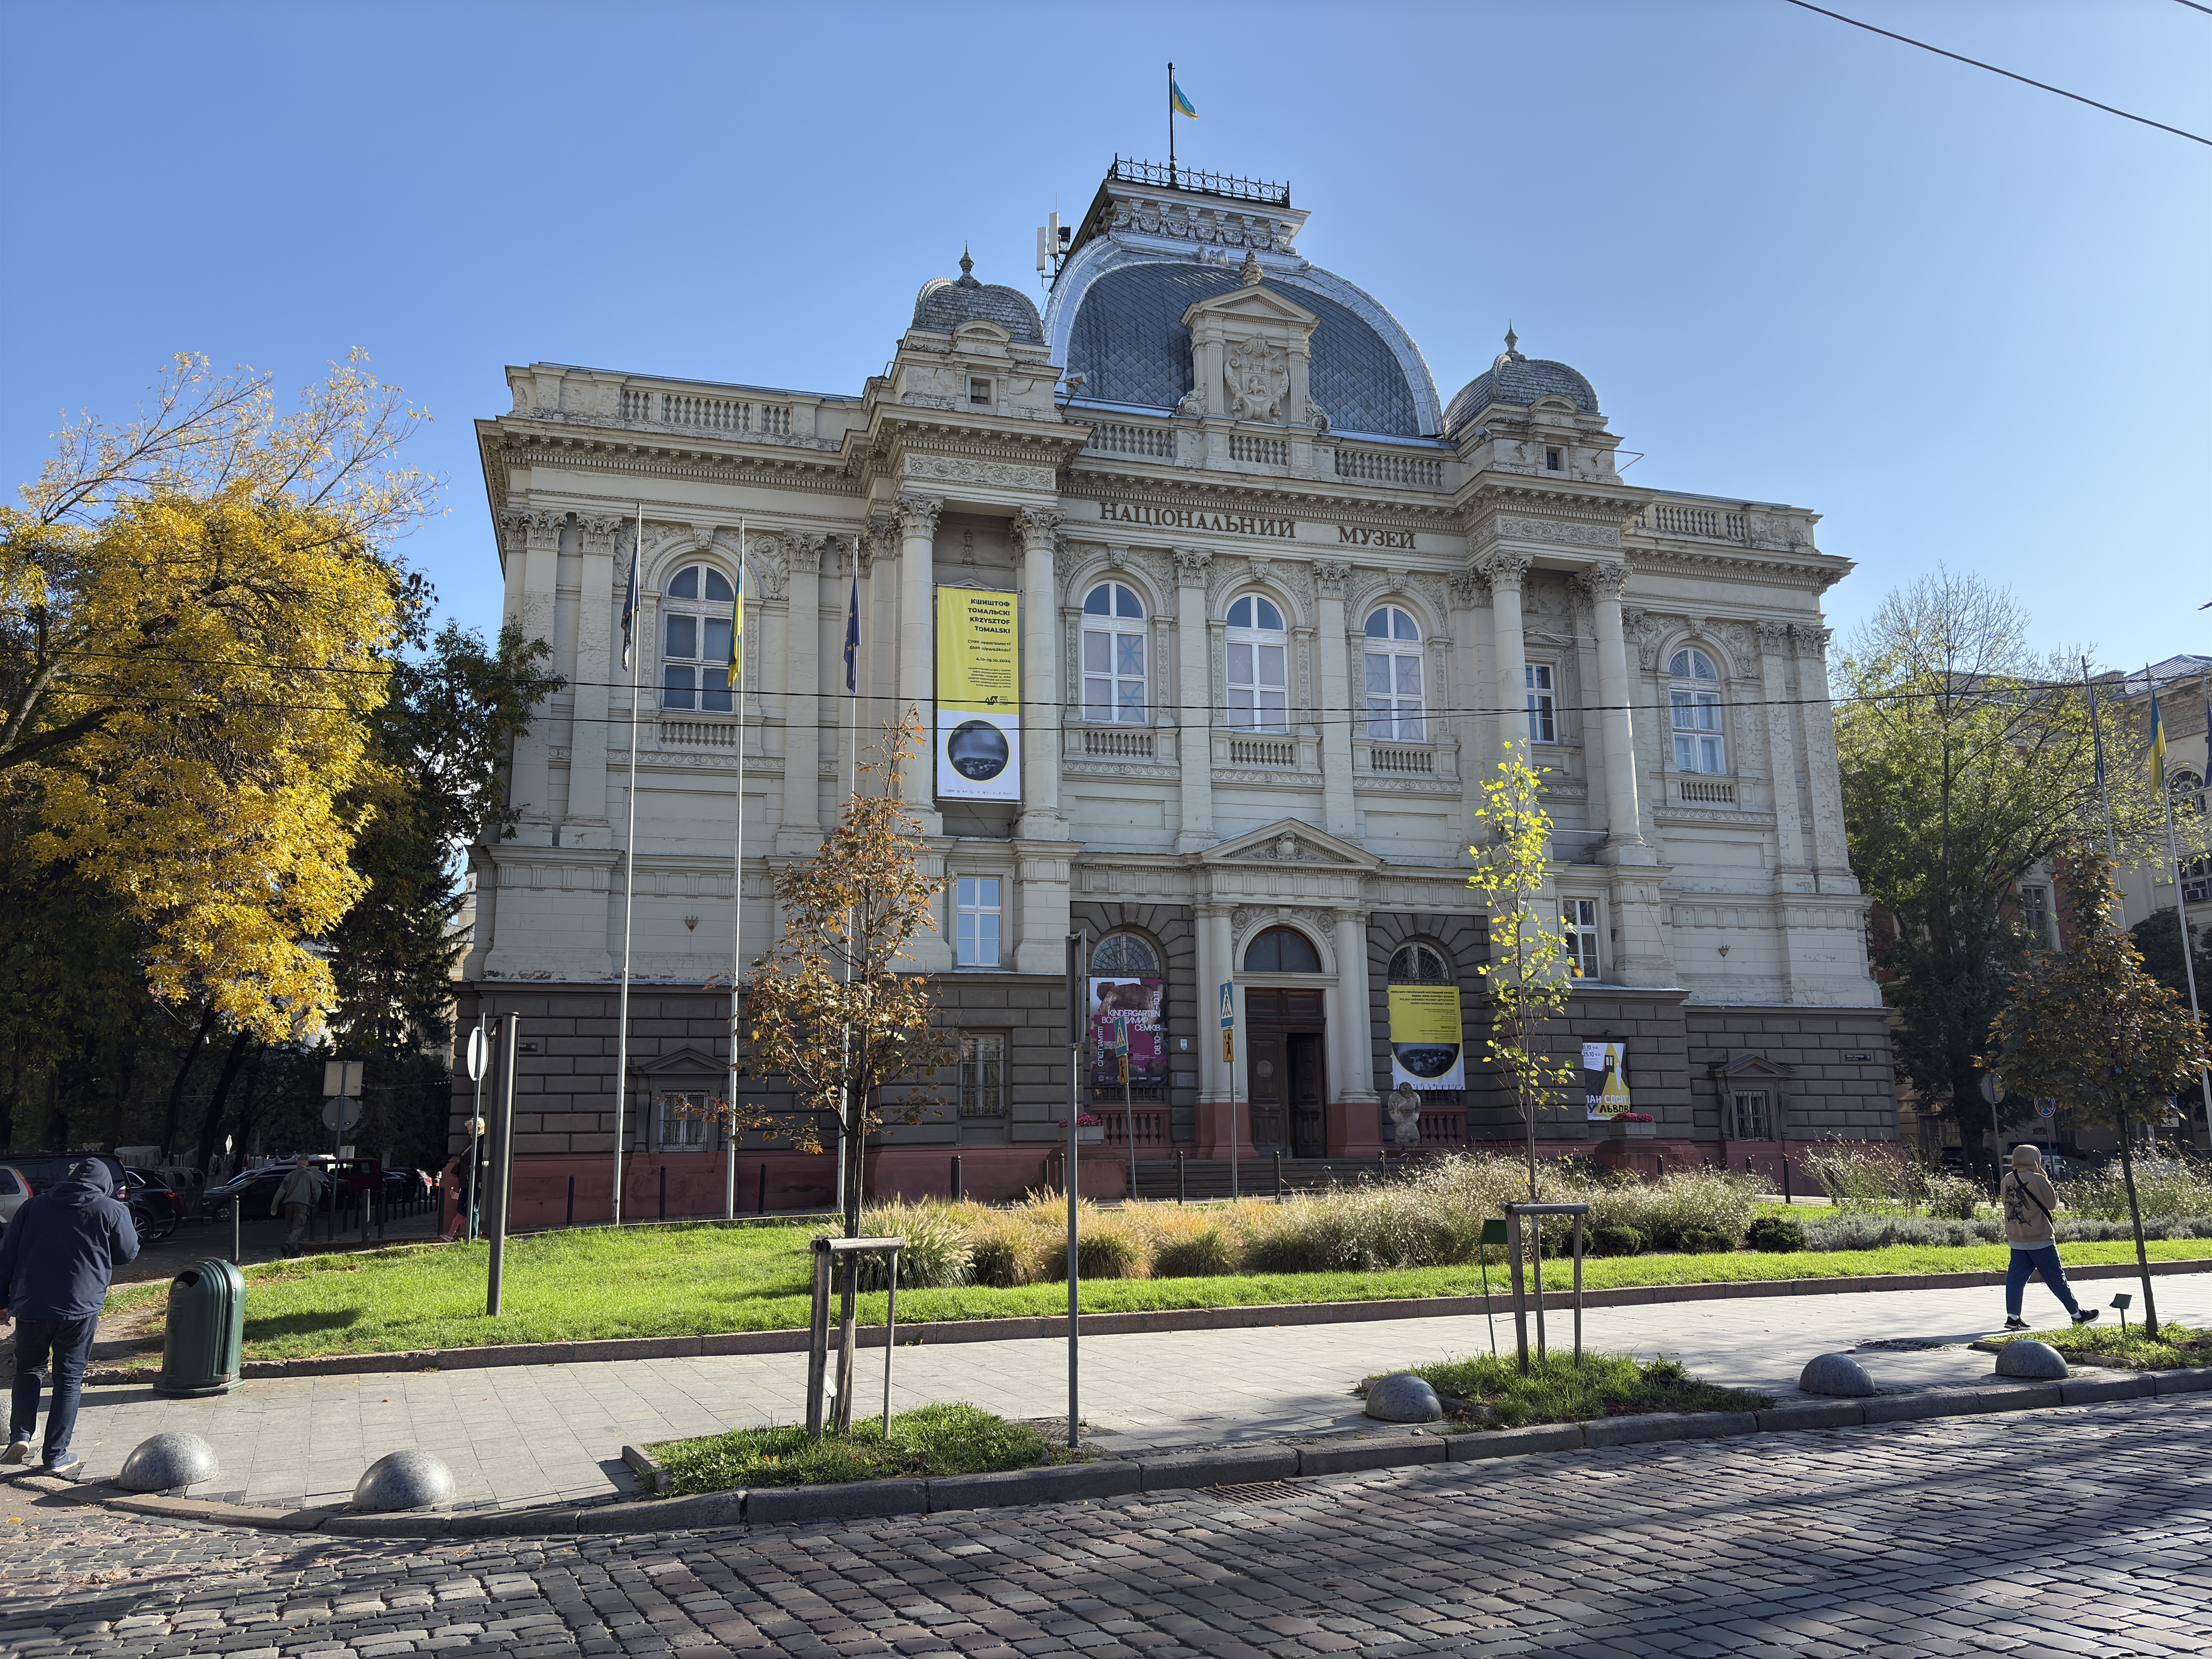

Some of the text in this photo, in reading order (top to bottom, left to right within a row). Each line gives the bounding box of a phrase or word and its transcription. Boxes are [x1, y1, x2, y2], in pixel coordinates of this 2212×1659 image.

[1099, 502, 1416, 549] НАЦІОНАЛЬНИЙ МУЗЕЙ
[970, 617, 1010, 625] KRZYSZTOF
[974, 625, 1010, 634] TOMALSKI
[1588, 1105, 1597, 1113] У
